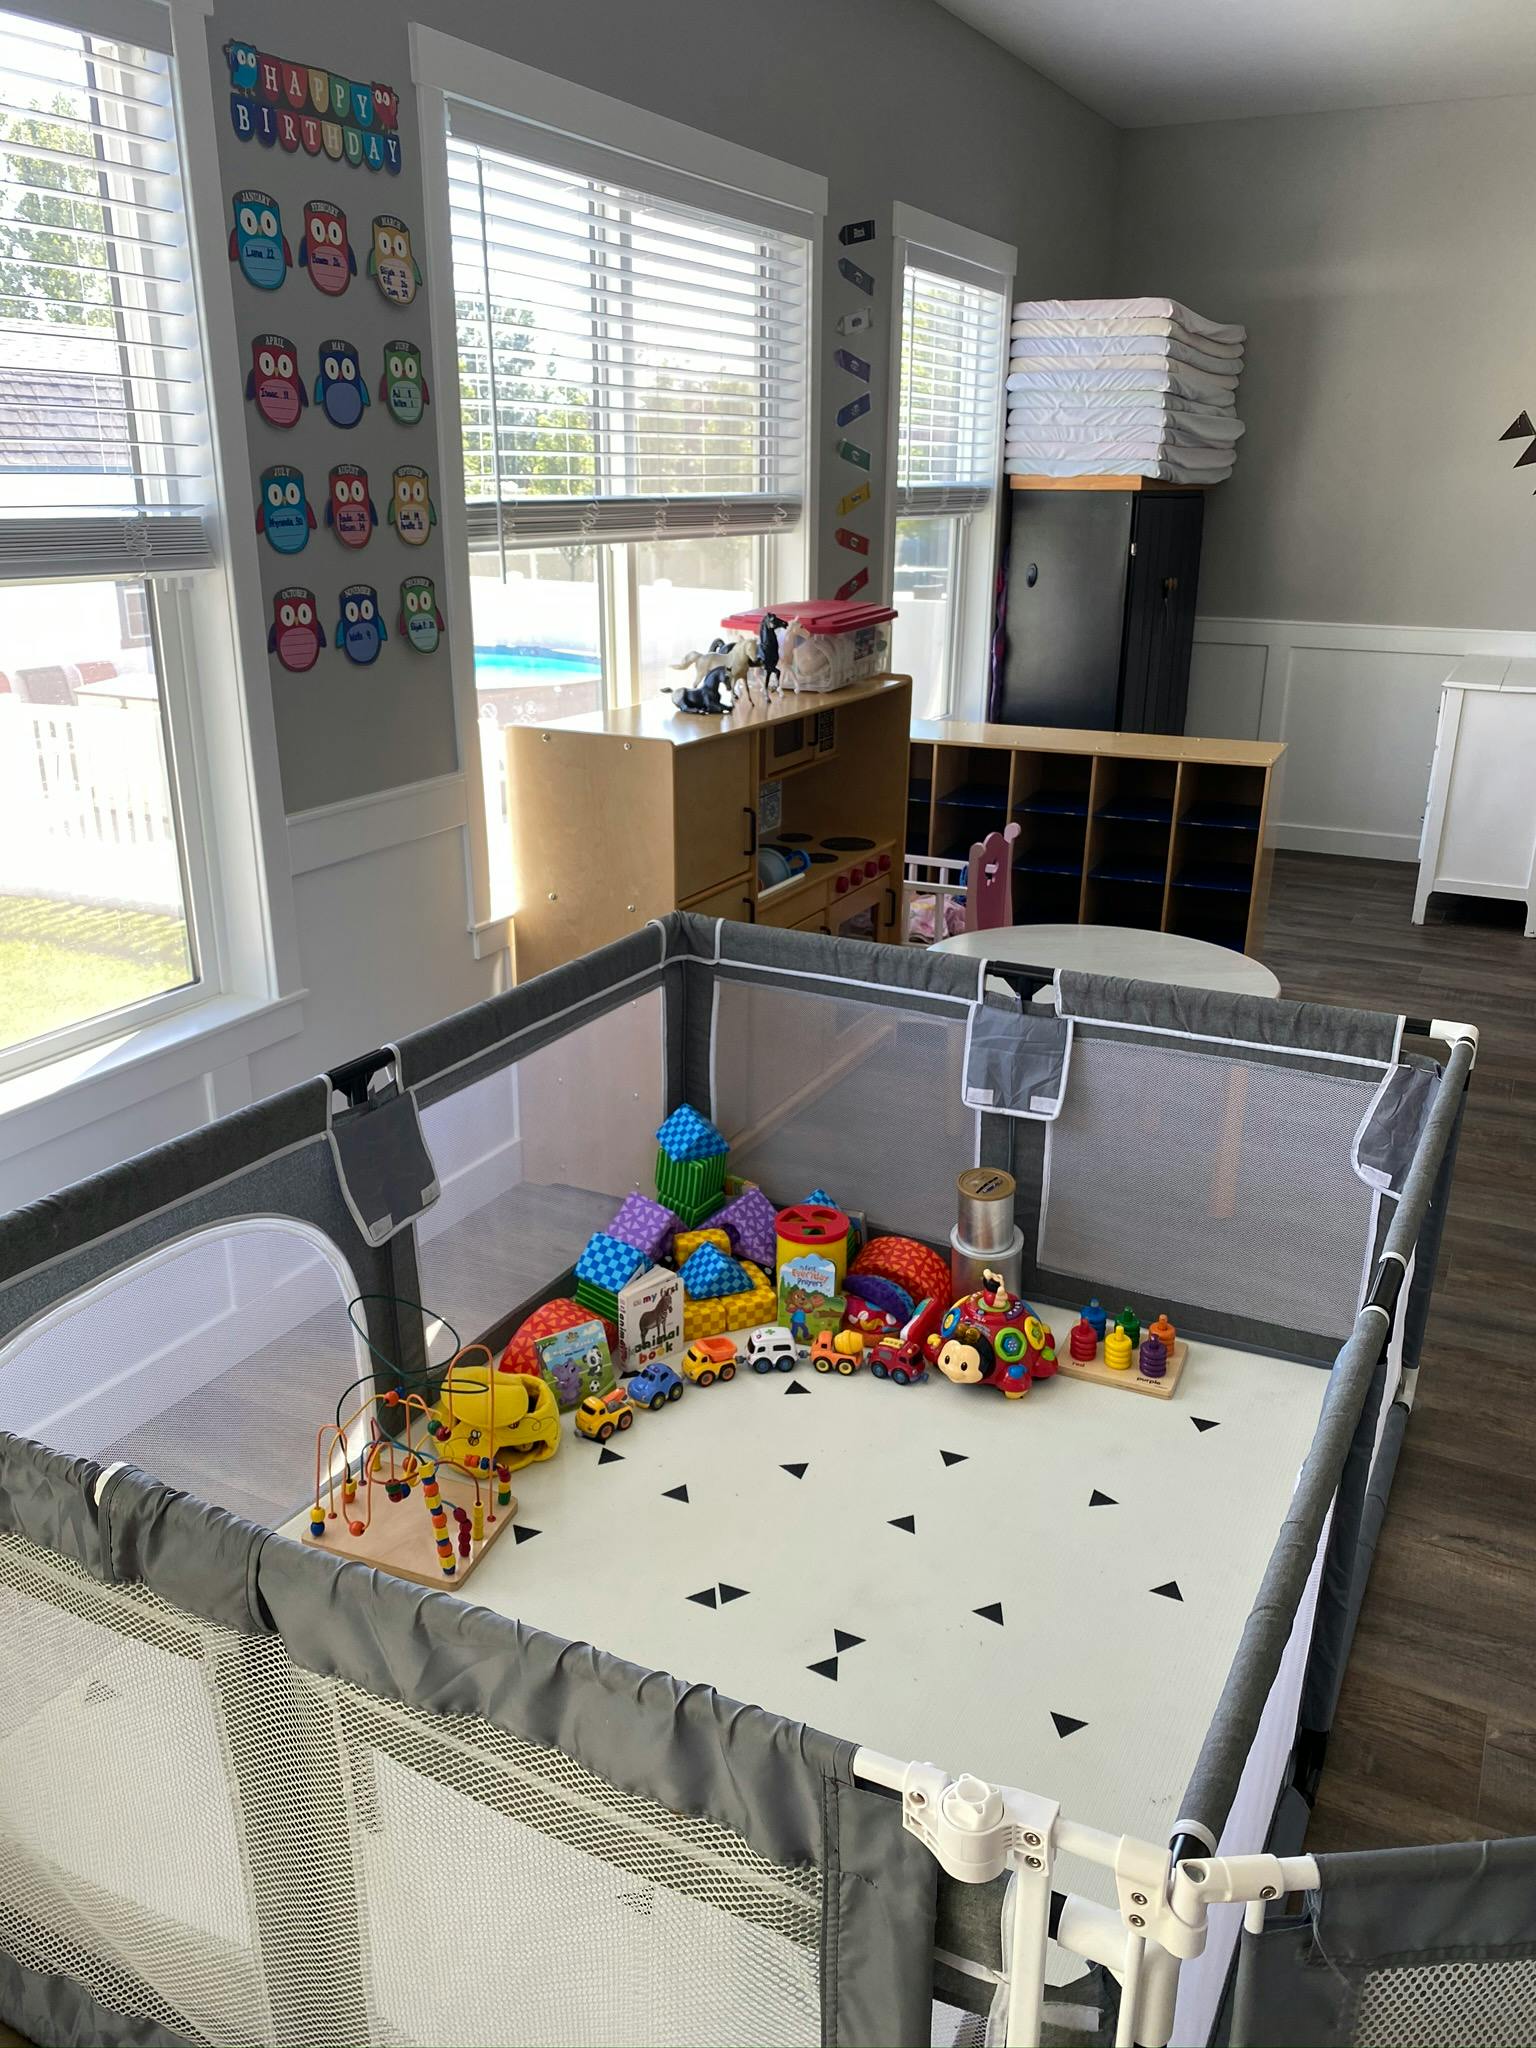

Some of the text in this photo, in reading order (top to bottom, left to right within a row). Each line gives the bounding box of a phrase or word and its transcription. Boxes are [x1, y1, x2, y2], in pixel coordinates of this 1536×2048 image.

[264, 64, 367, 118] HAPPY
[236, 104, 397, 163] BIRTHDAY
[241, 192, 271, 206] JANUARY
[311, 202, 340, 217] FEBRUARY
[381, 217, 401, 229] MARCH
[265, 336, 285, 349] APRIL
[331, 341, 345, 352] MAY
[395, 343, 409, 352] JUNE
[274, 467, 290, 477] JULY
[337, 465, 359, 475] AUGUST
[282, 589, 307, 600] OCTOBER
[344, 586, 371, 598] NOVEMBER
[791, 1268, 829, 1282] Everyday
[797, 1277, 824, 1288] Prayers
[643, 1292, 658, 1304] my
[660, 1283, 679, 1298] first
[634, 1326, 680, 1354] animal
[639, 1341, 673, 1365] book
[1136, 1376, 1162, 1386] purple
